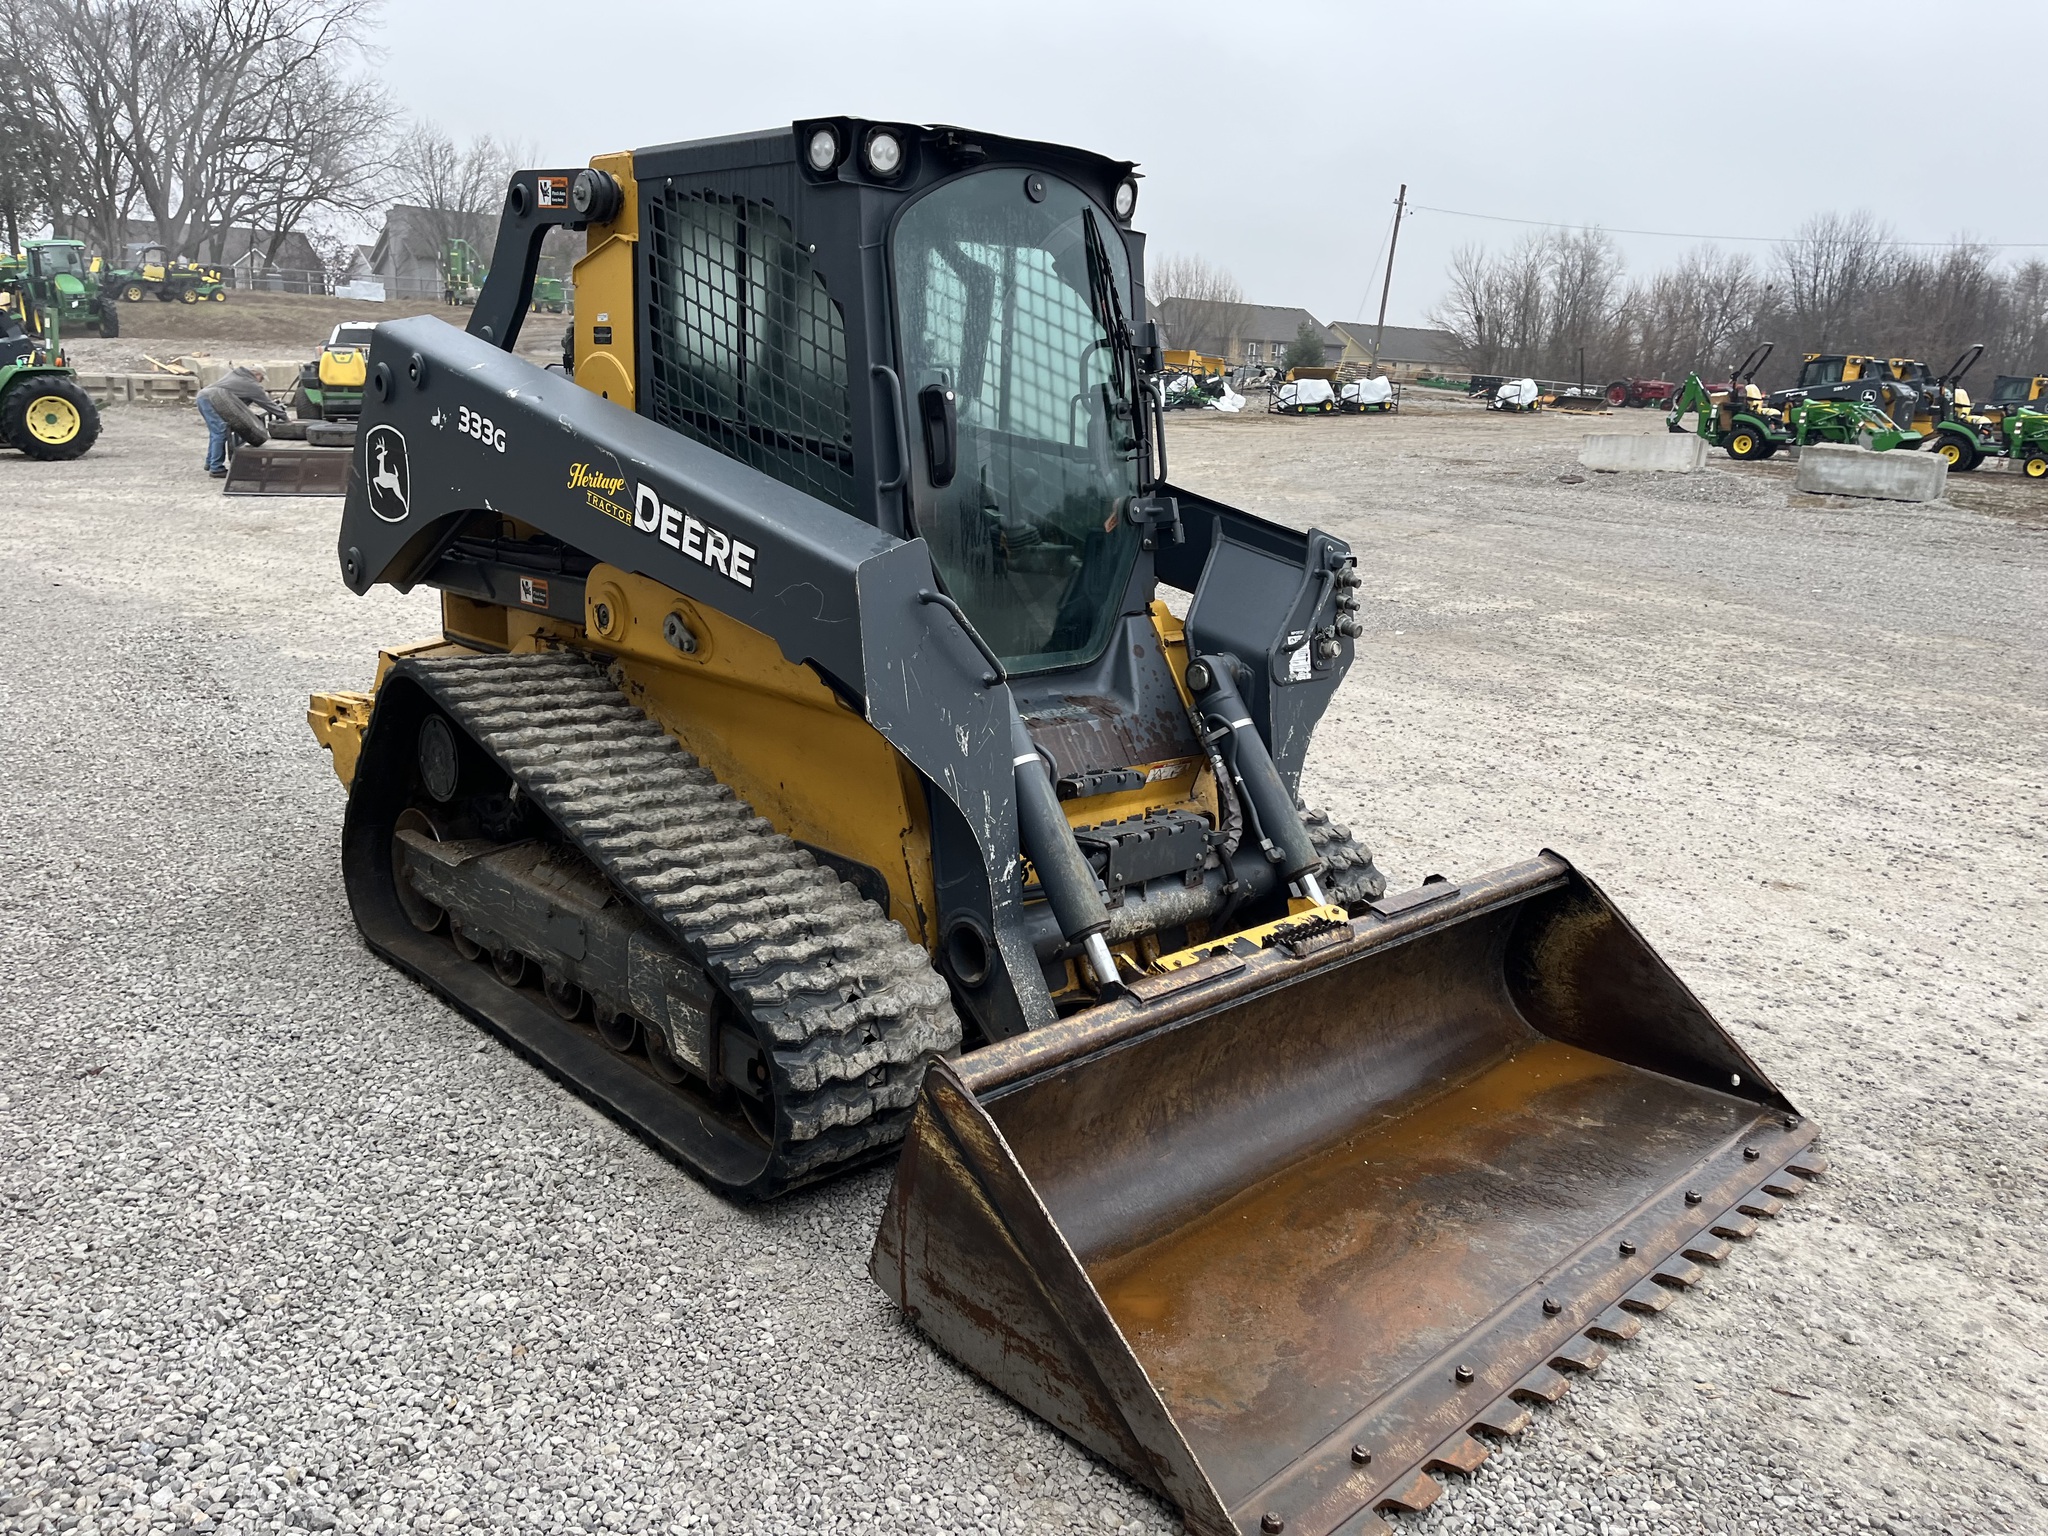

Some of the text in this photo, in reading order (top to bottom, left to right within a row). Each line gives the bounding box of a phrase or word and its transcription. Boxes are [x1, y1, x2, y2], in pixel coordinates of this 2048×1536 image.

[458, 405, 506, 453] 333G
[567, 462, 626, 496] Heritage
[586, 491, 632, 525] TRACTOR
[634, 482, 755, 588] DEERE
